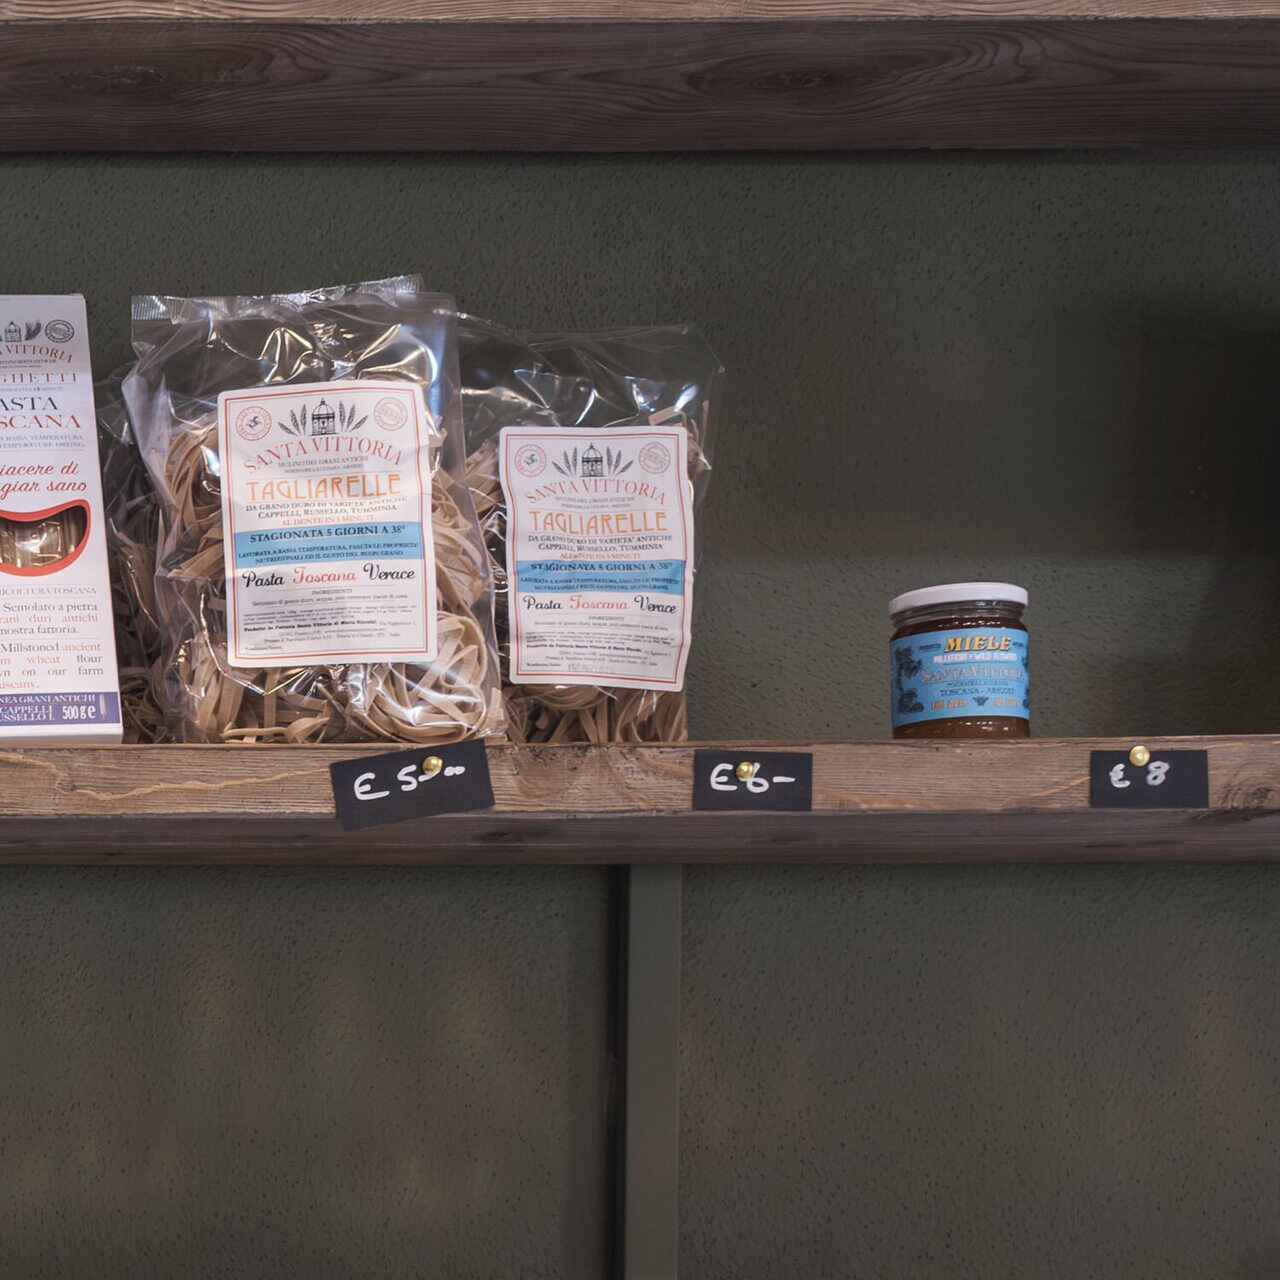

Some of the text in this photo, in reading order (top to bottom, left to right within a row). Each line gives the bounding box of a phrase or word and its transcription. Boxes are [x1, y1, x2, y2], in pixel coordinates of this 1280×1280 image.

[242, 436, 403, 474] SANTA VITTORIA
[47, 483, 88, 495] sano
[245, 474, 401, 501] TAGLIARELLE
[529, 511, 668, 535] TAGLIARELLE
[242, 562, 415, 588] Pasta Toscana Verace
[523, 594, 676, 615] Pasta Toscana Verace
[944, 635, 1012, 653] MIELE
